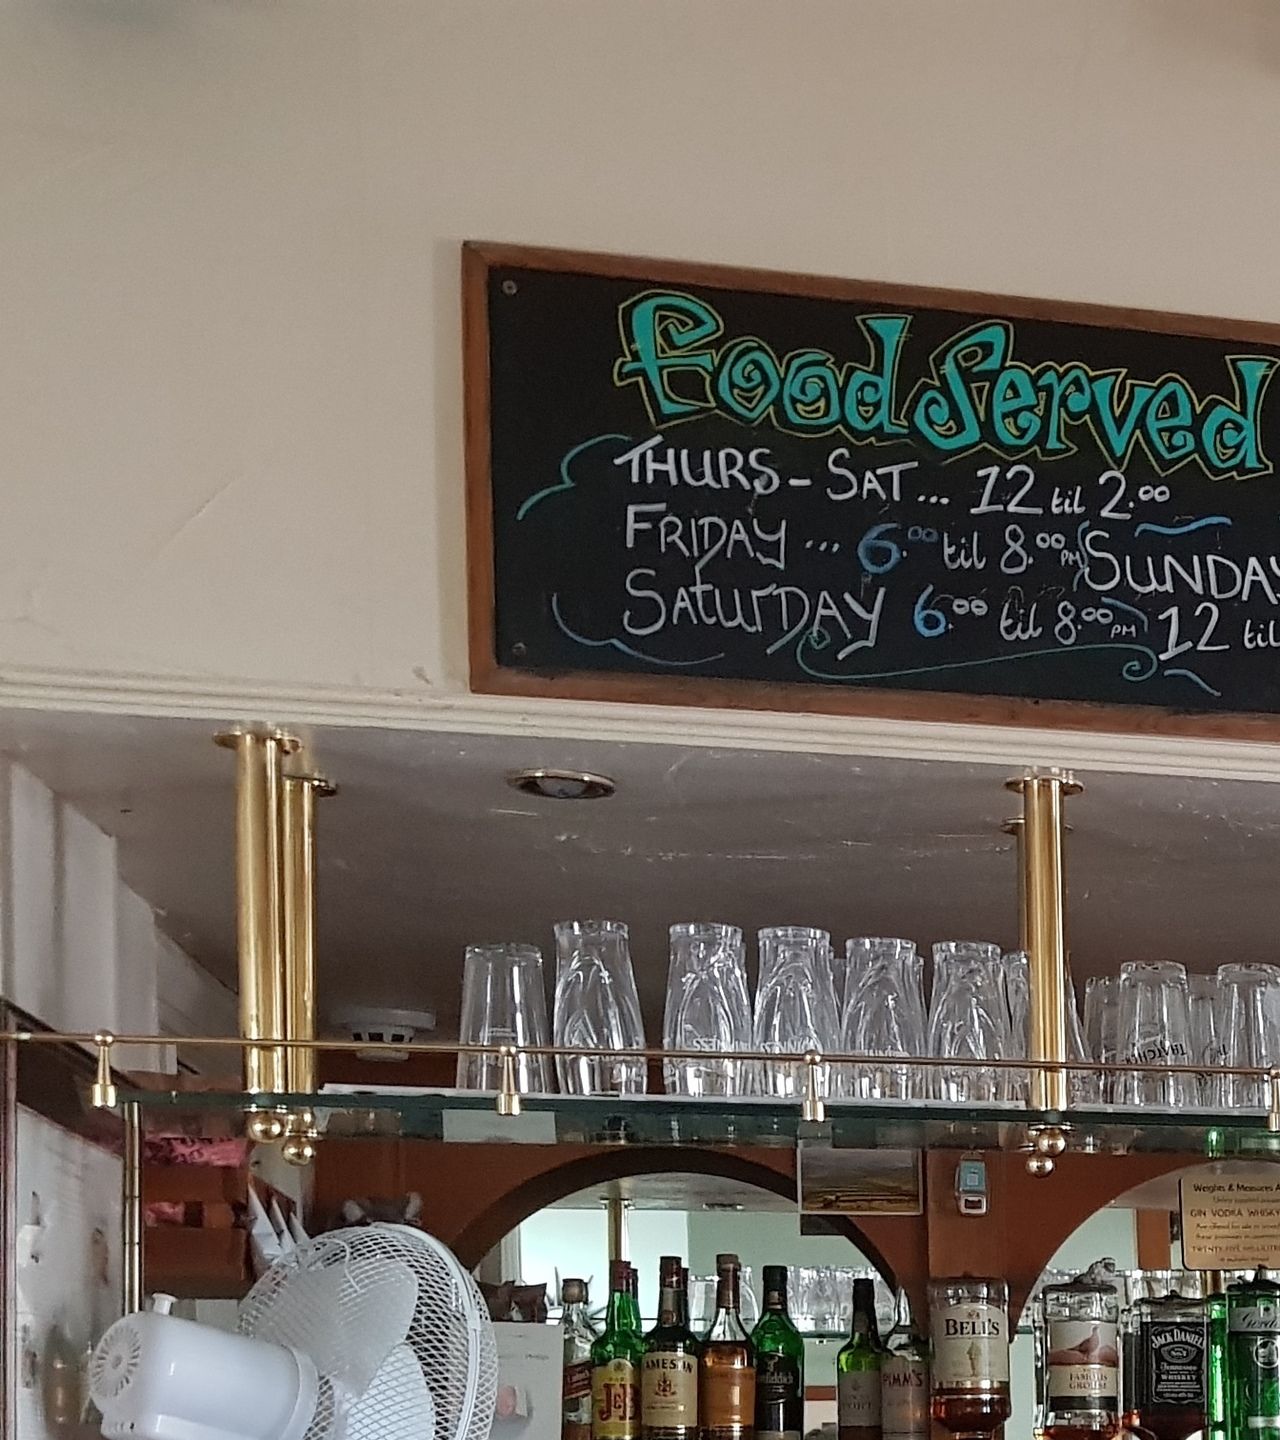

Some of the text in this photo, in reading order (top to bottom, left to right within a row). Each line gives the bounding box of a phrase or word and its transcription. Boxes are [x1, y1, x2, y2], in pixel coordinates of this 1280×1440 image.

[615, 290, 913, 440] Food
[971, 465, 1043, 514] 12
[1052, 486, 1085, 514] til
[943, 531, 986, 571] til
[1000, 605, 1042, 641] til
[1158, 603, 1230, 660] 12
[1193, 1183, 1226, 1194] Weights
[1237, 1183, 1273, 1192] Measures
[1190, 1208, 1207, 1218] GIN
[1211, 1208, 1243, 1217] VODKA
[1247, 1207, 1280, 1217] WHISKY
[945, 1318, 1000, 1336] BELL'S
